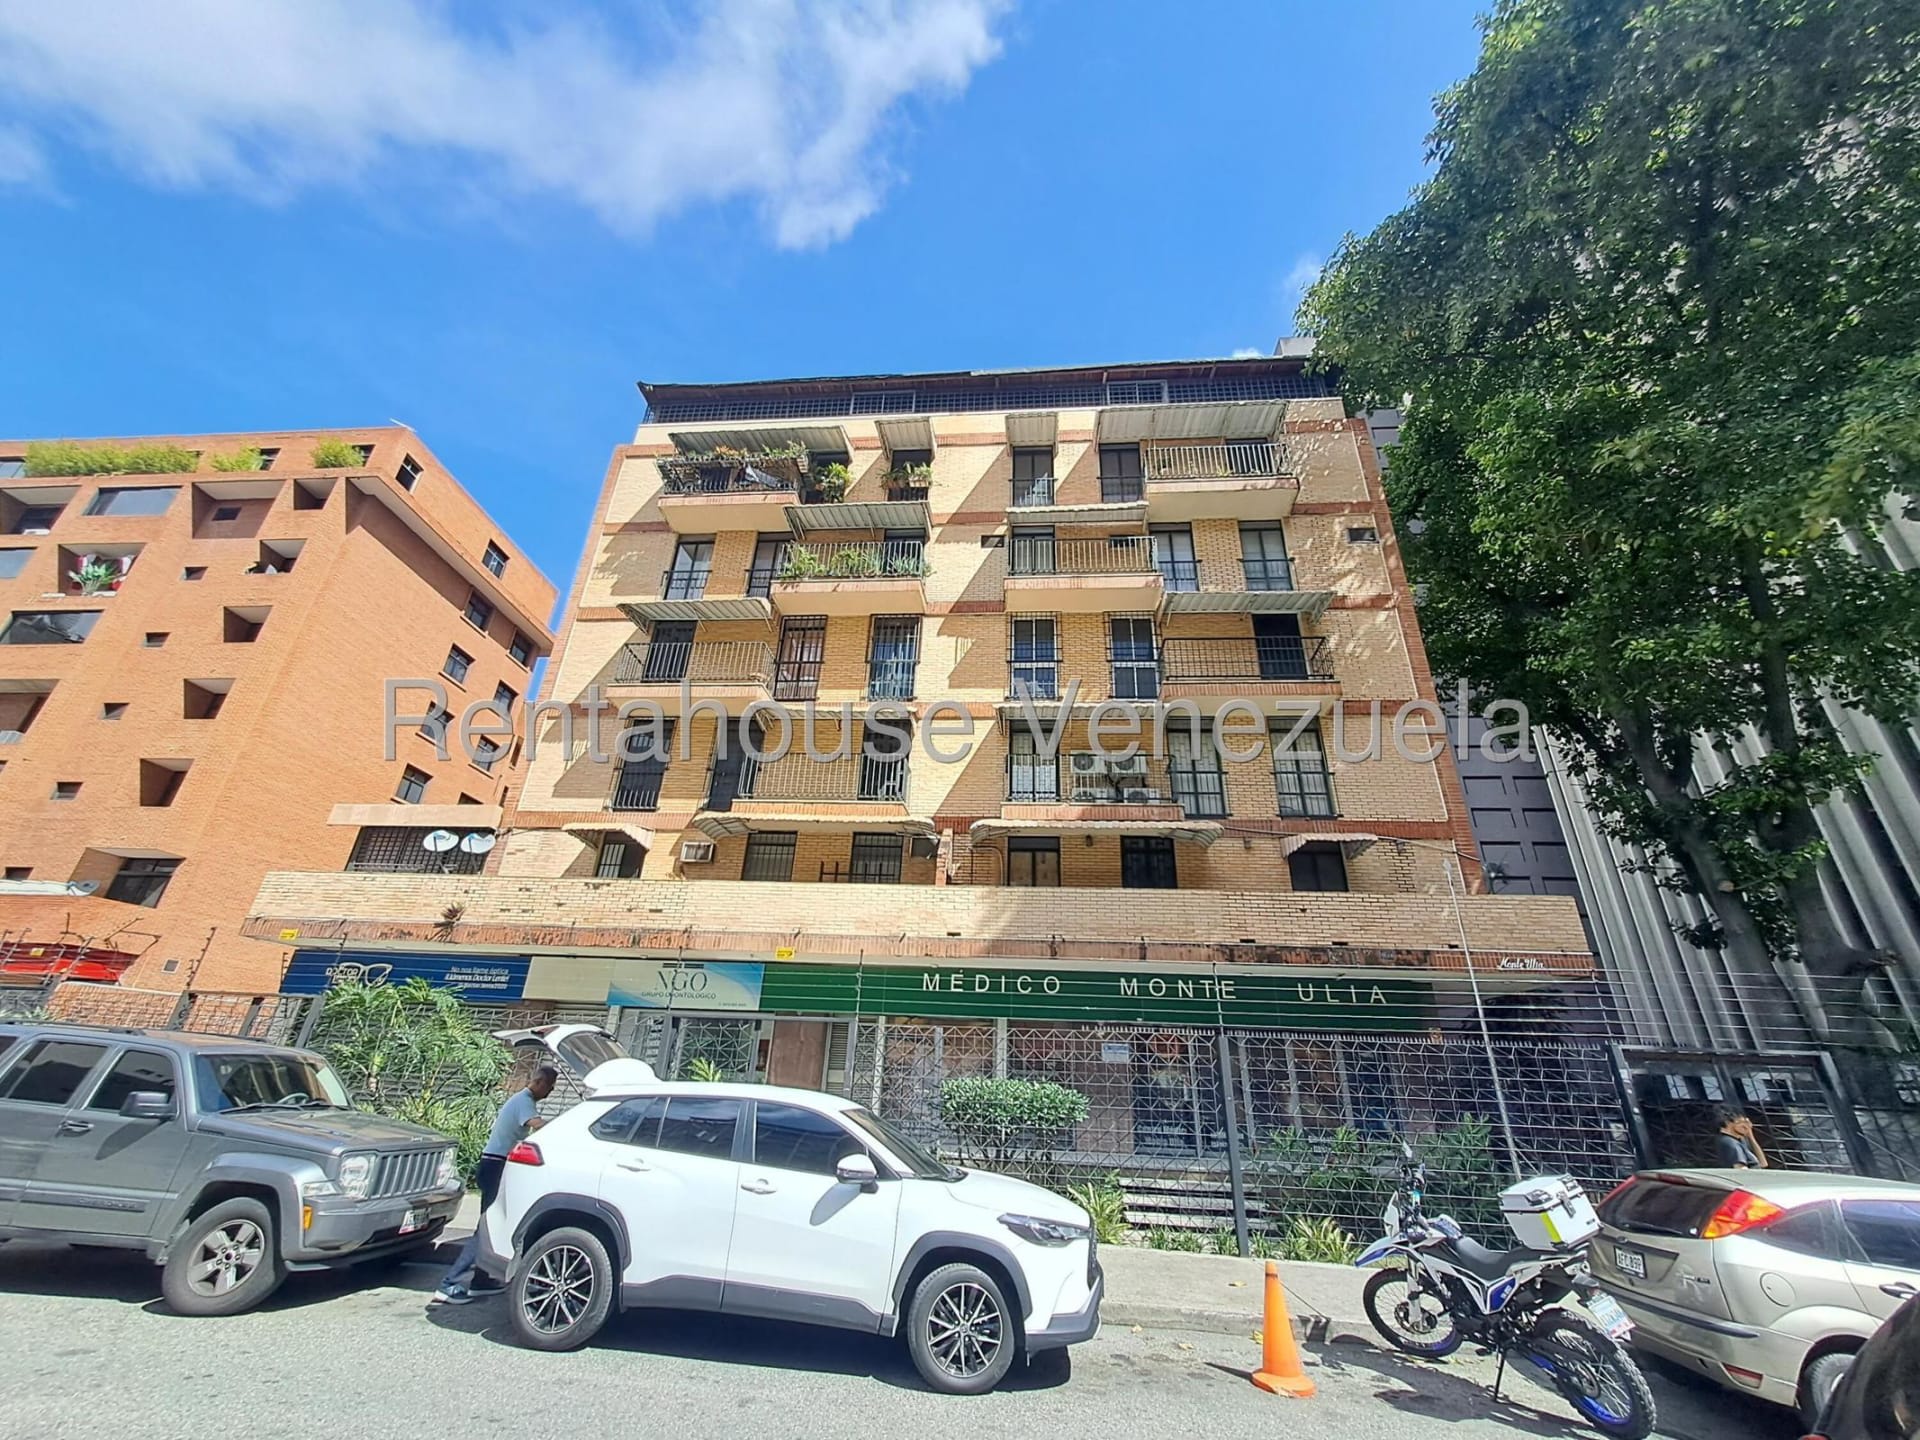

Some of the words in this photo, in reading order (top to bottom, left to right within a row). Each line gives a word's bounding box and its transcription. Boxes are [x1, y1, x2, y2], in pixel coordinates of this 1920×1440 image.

[657, 970, 708, 992] NGO
[922, 969, 1061, 994] MÉDICO
[1119, 977, 1237, 999] MONTE
